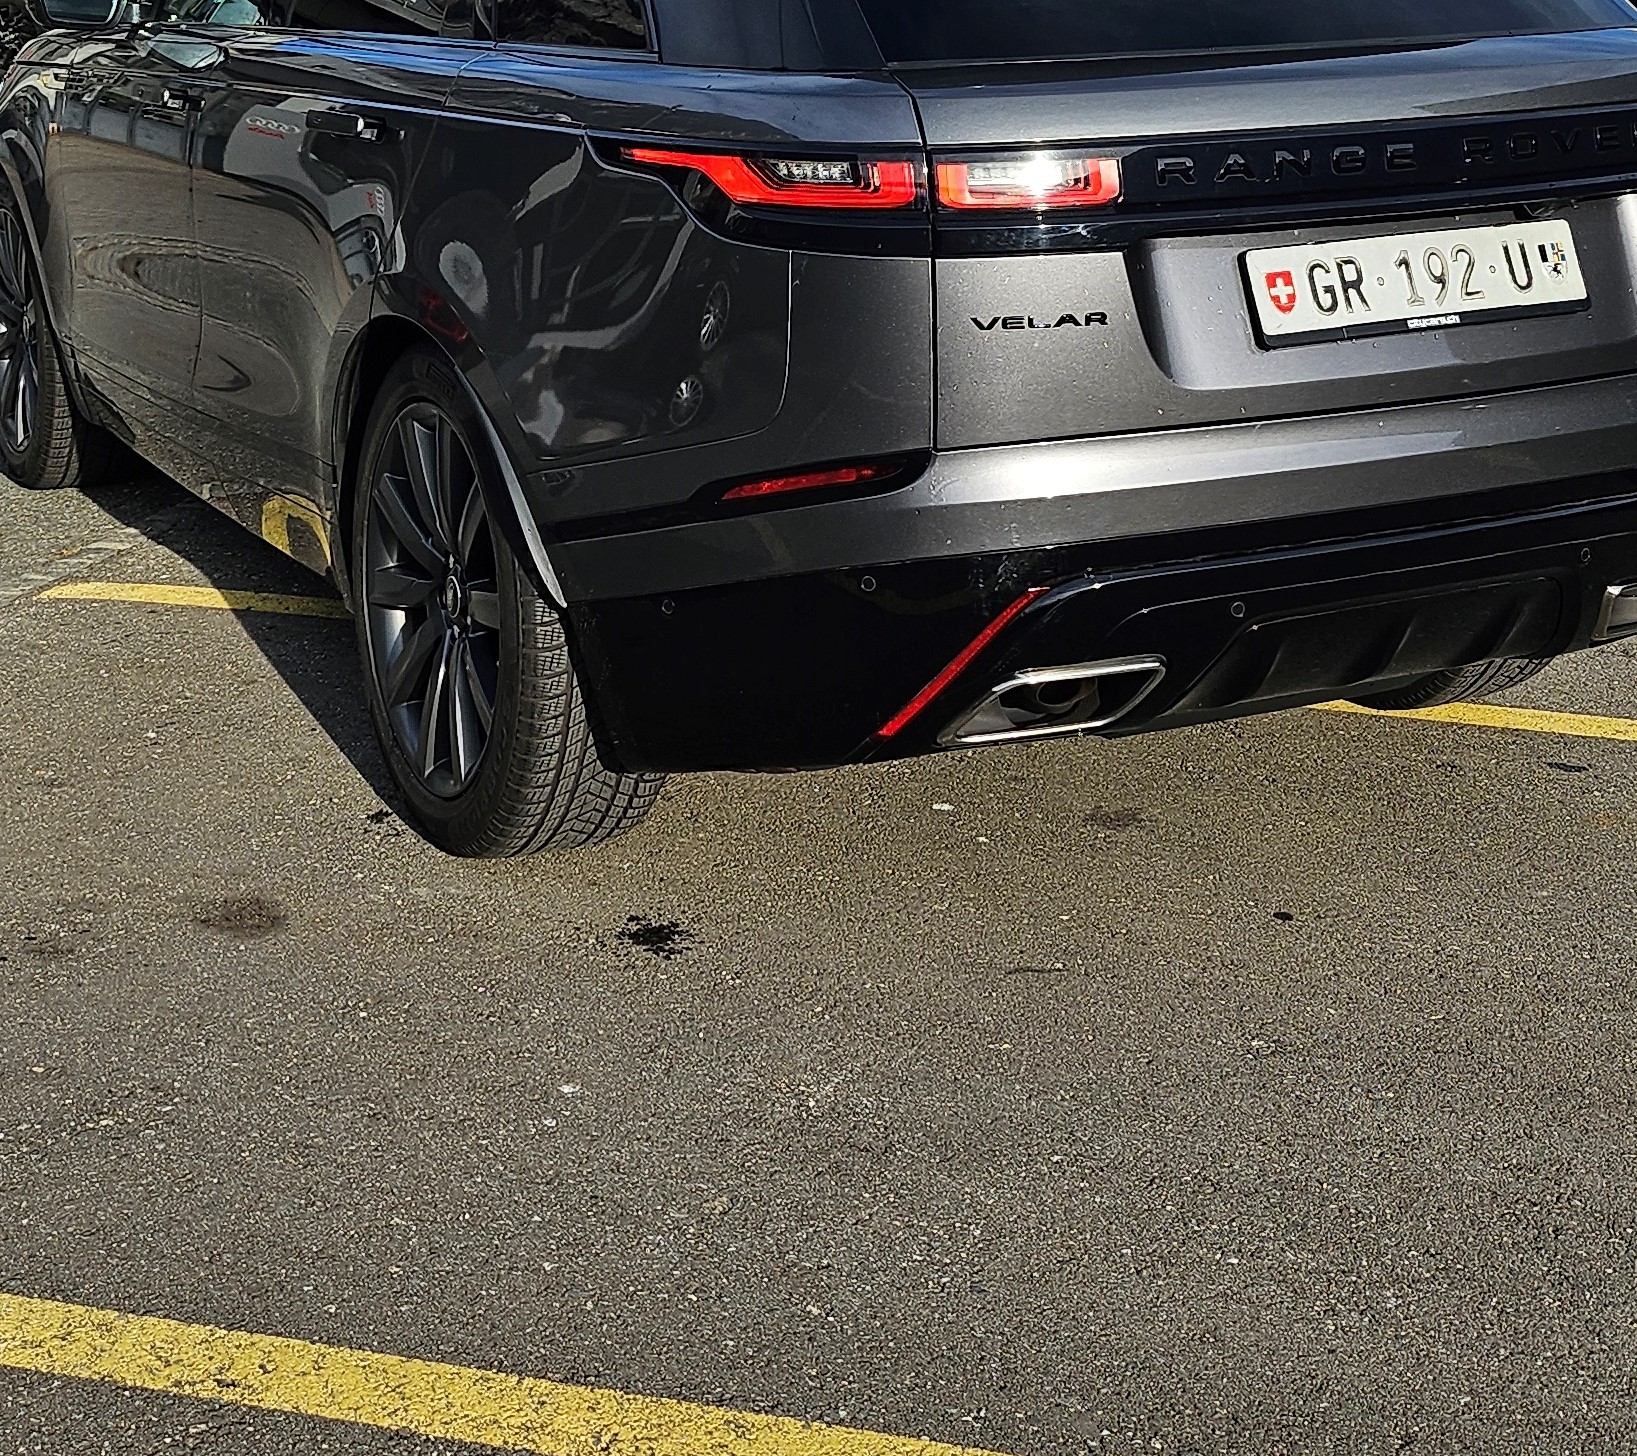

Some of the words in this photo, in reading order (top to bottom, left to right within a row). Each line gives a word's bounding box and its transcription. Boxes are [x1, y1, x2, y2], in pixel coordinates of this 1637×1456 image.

[1155, 142, 1417, 187] RANGE
[1462, 120, 1637, 167] ROVE
[969, 310, 1109, 331] VELAR
